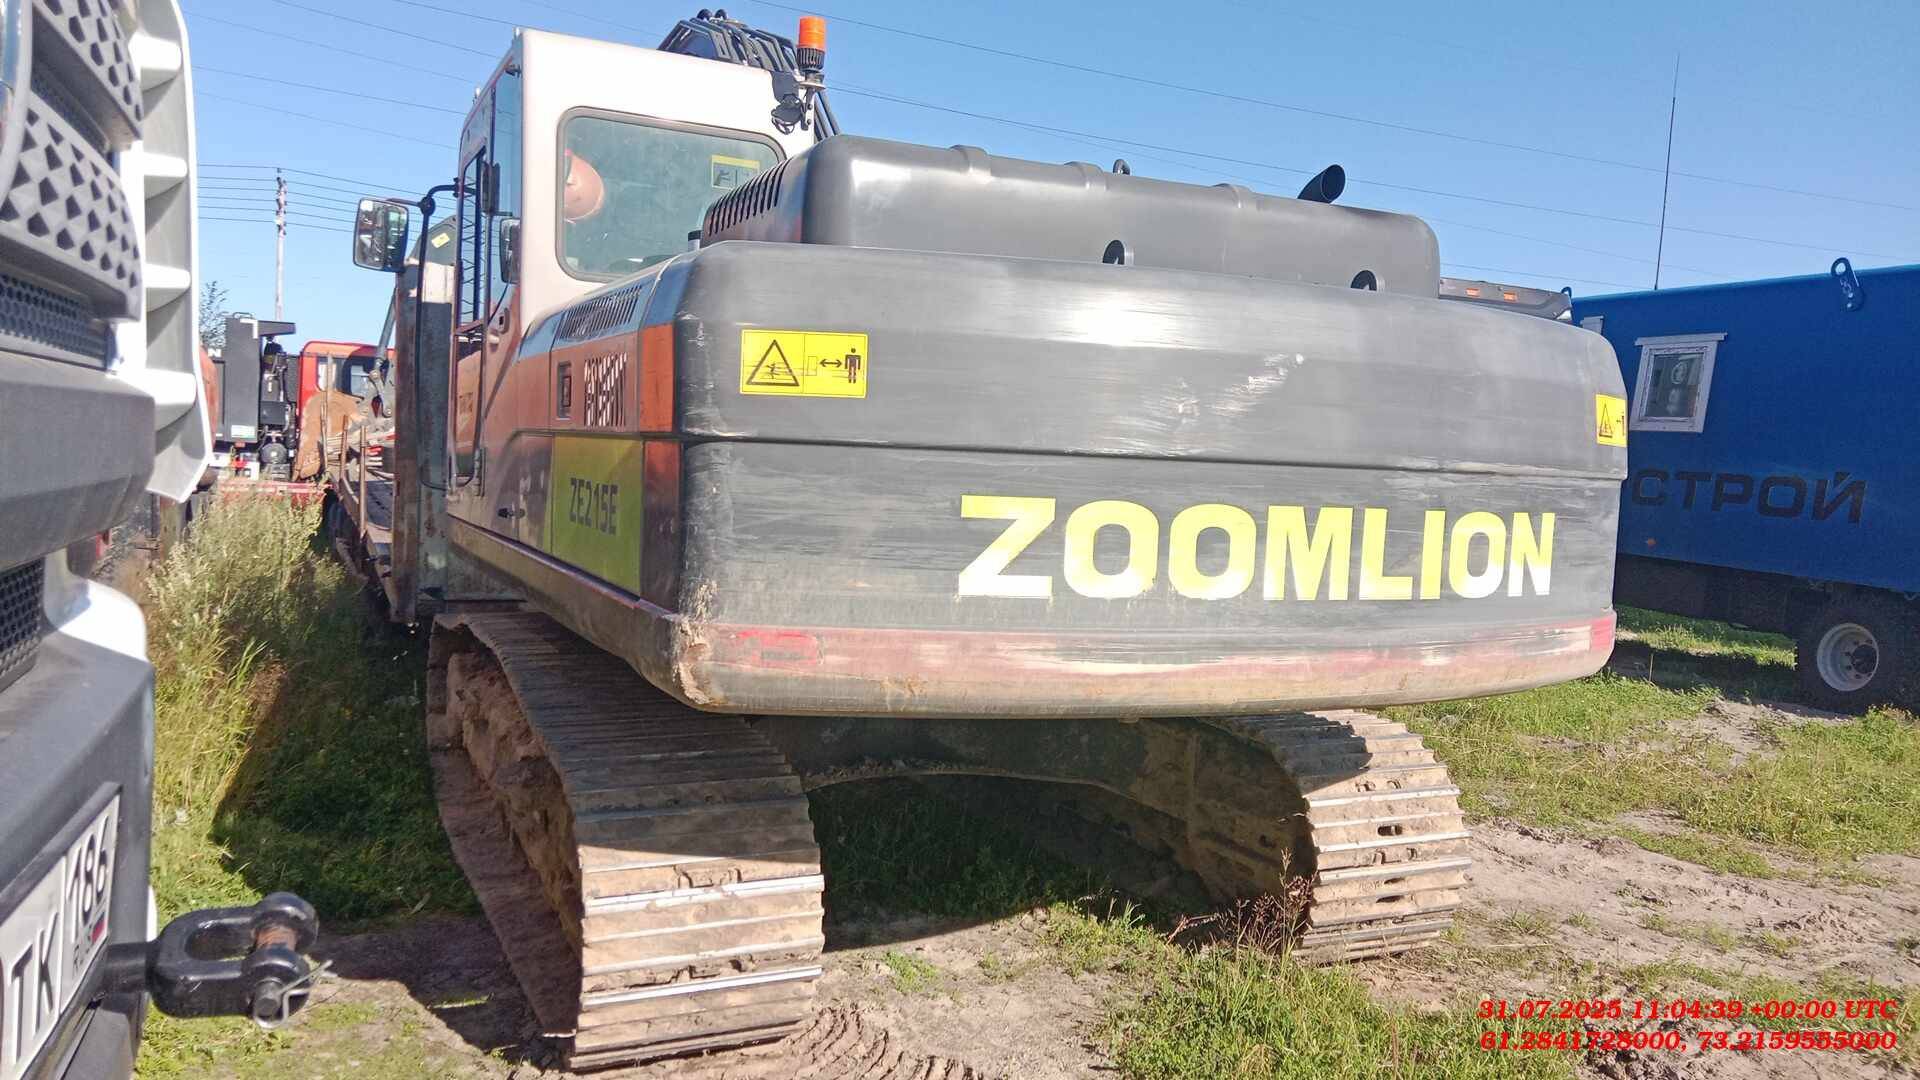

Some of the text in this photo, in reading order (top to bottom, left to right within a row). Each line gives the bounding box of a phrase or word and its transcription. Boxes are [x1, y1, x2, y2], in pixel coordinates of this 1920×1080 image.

[568, 477, 618, 535] ZE215E
[1632, 468, 1868, 526] СТРОЙ
[957, 494, 1557, 601] ZOOMLION
[66, 816, 108, 944] 186
